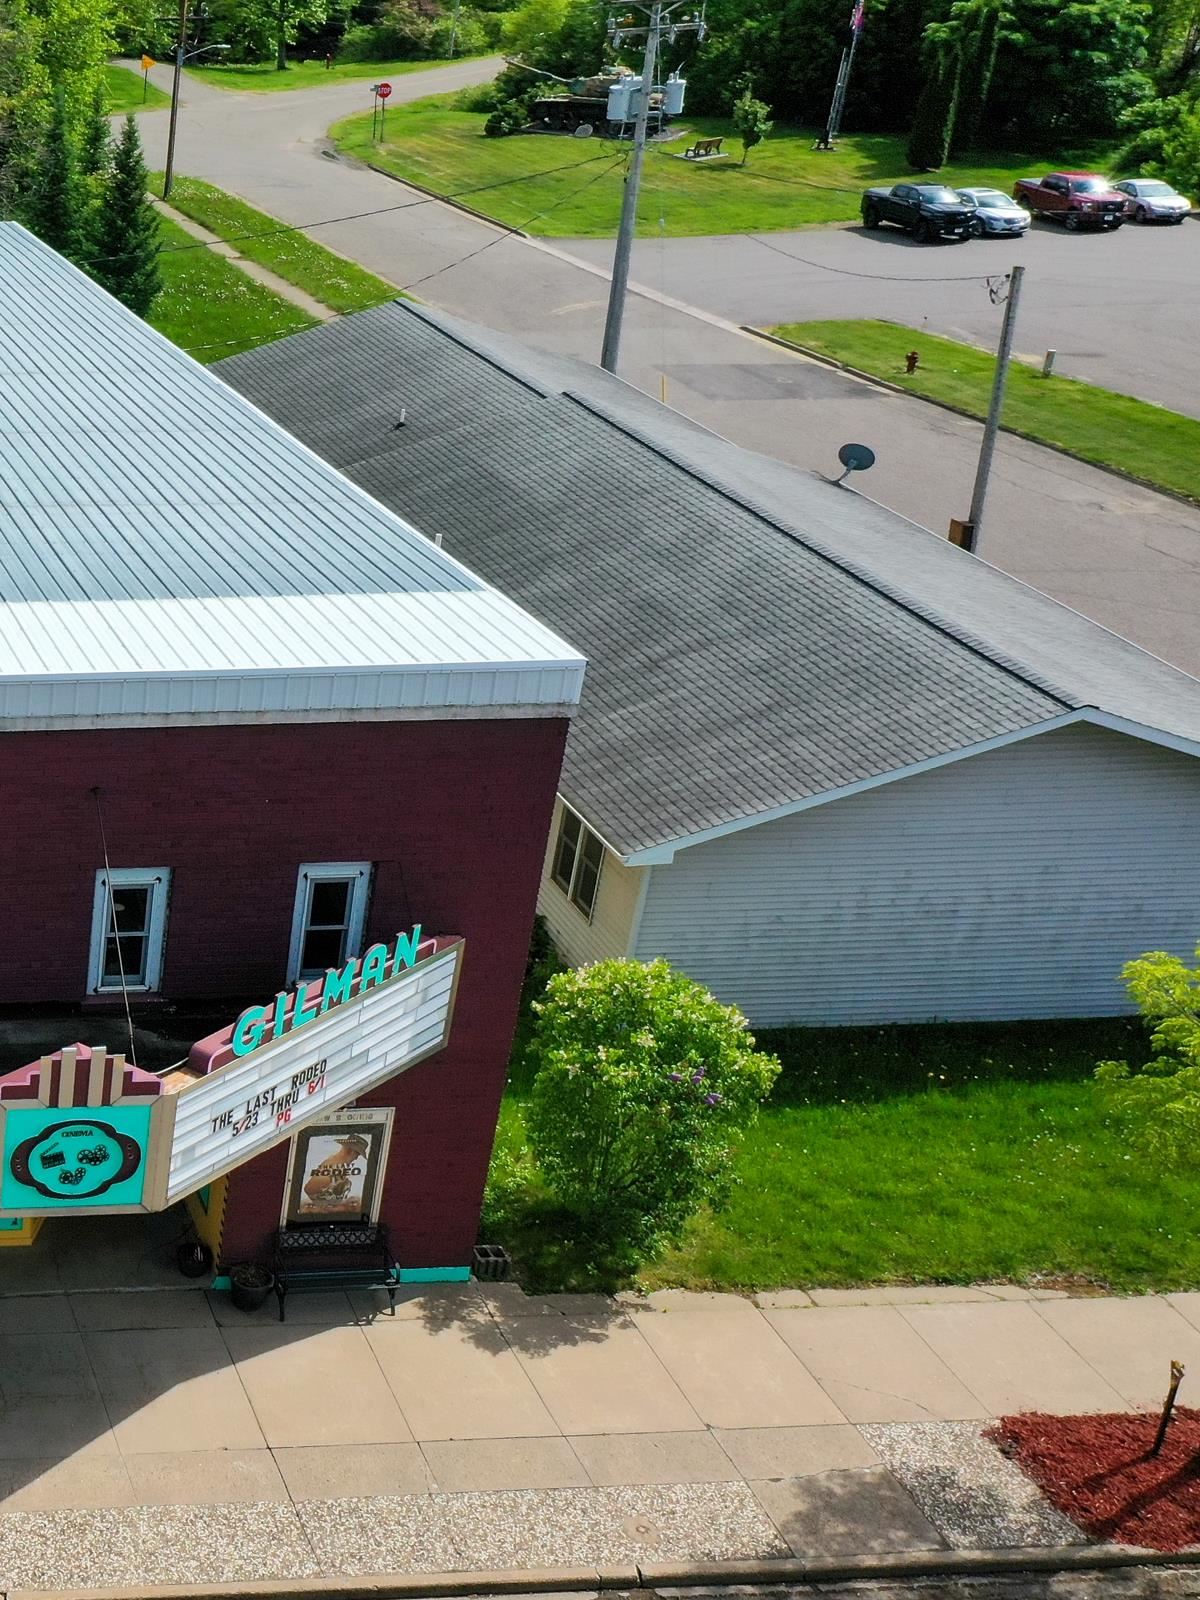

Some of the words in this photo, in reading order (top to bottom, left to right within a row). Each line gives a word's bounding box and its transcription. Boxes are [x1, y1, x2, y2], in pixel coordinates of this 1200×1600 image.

[232, 923, 422, 1057] GILMAN
[212, 1109, 234, 1133] THE
[246, 1086, 277, 1115] LAST
[291, 1059, 327, 1091] RODEO
[232, 1111, 259, 1138] 5/23
[270, 1088, 300, 1117] THRU
[307, 1074, 326, 1096] 6/1
[61, 1130, 94, 1138] CINEMA
[276, 1108, 292, 1128] PG
[310, 1167, 362, 1177] RODEO
